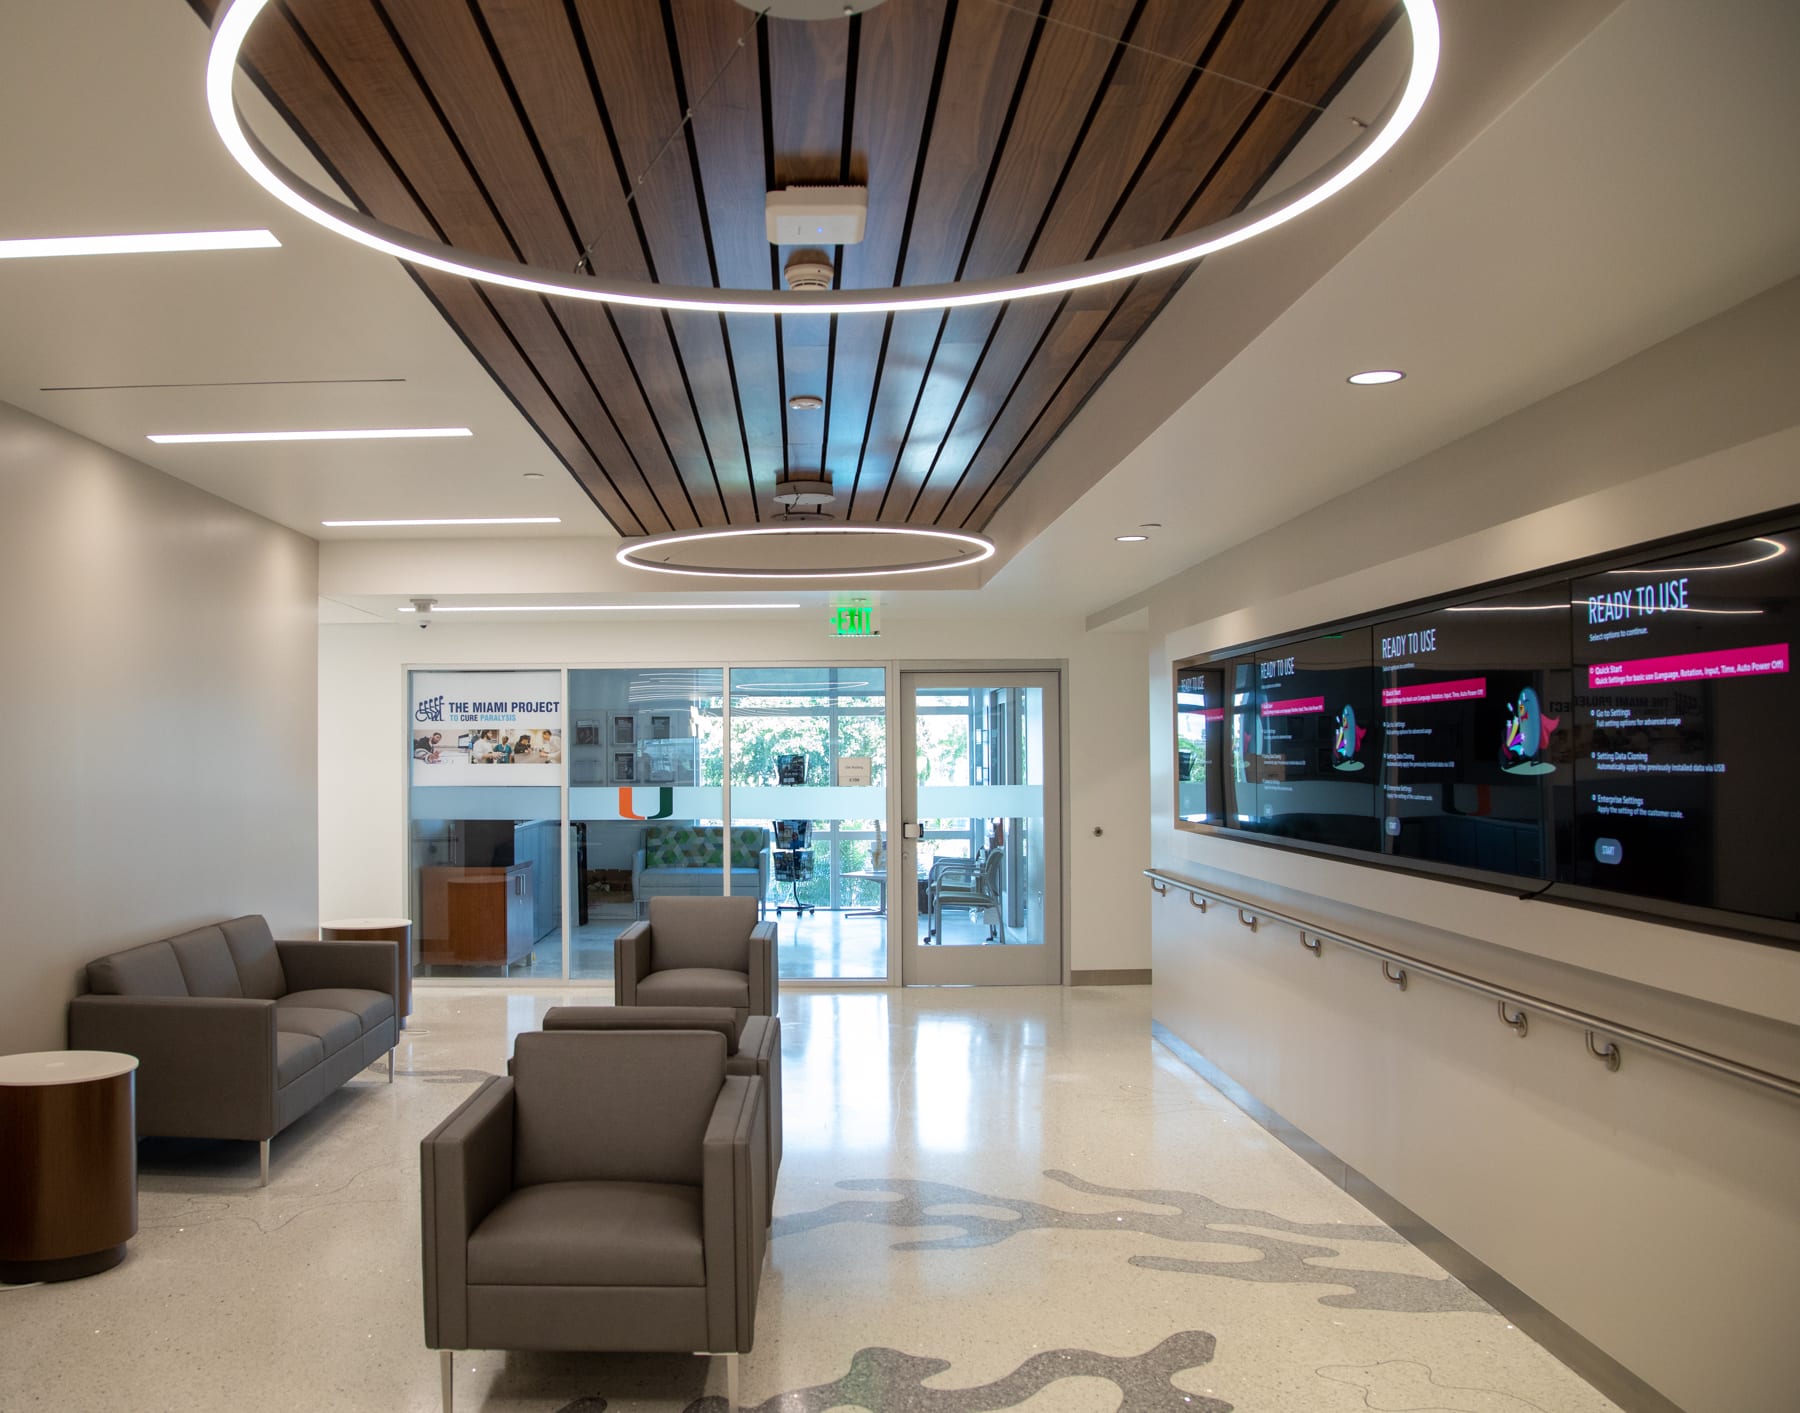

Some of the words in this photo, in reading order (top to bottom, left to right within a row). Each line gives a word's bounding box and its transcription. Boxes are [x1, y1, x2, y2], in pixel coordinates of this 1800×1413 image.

[1588, 589, 1632, 625] READY
[1635, 585, 1655, 616] TO
[1658, 578, 1689, 612] USE
[837, 607, 873, 635] EXIT
[1382, 635, 1407, 659] READY
[1408, 632, 1419, 655] TO
[1420, 628, 1437, 653] USE
[1261, 662, 1277, 679] READY
[1277, 659, 1284, 677] TO
[1284, 657, 1295, 676] USE
[449, 702, 469, 713] THE
[472, 702, 508, 713] MIAMI
[511, 701, 560, 713] PROJECT
[450, 714, 459, 722] TO
[460, 714, 478, 722] CURE
[480, 714, 517, 722] PARALYSIS
[618, 786, 673, 820] U
